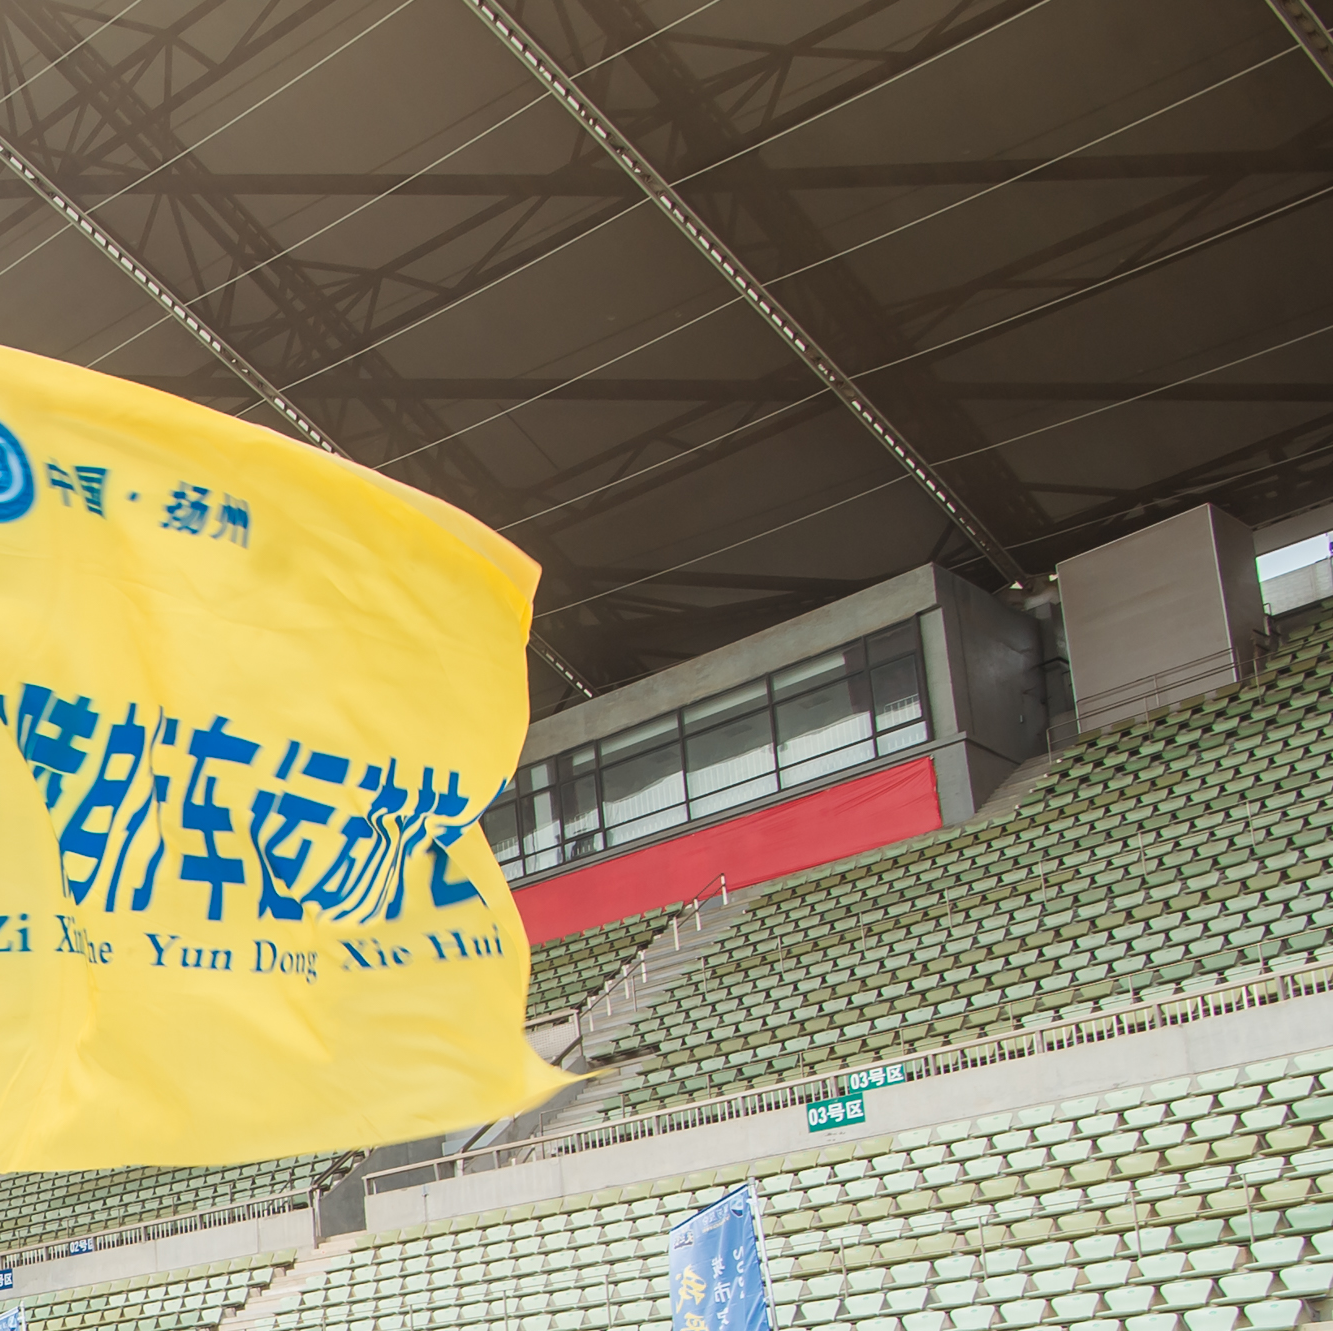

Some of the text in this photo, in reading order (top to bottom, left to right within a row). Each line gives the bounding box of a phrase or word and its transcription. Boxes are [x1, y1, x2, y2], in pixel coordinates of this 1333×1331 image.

[144, 932, 234, 971] Yun
[252, 939, 319, 984] Dong
[339, 937, 411, 969] Xie
[424, 924, 505, 961] Hui
[849, 1064, 905, 1090] 03号区
[808, 1099, 864, 1126] 03号区
